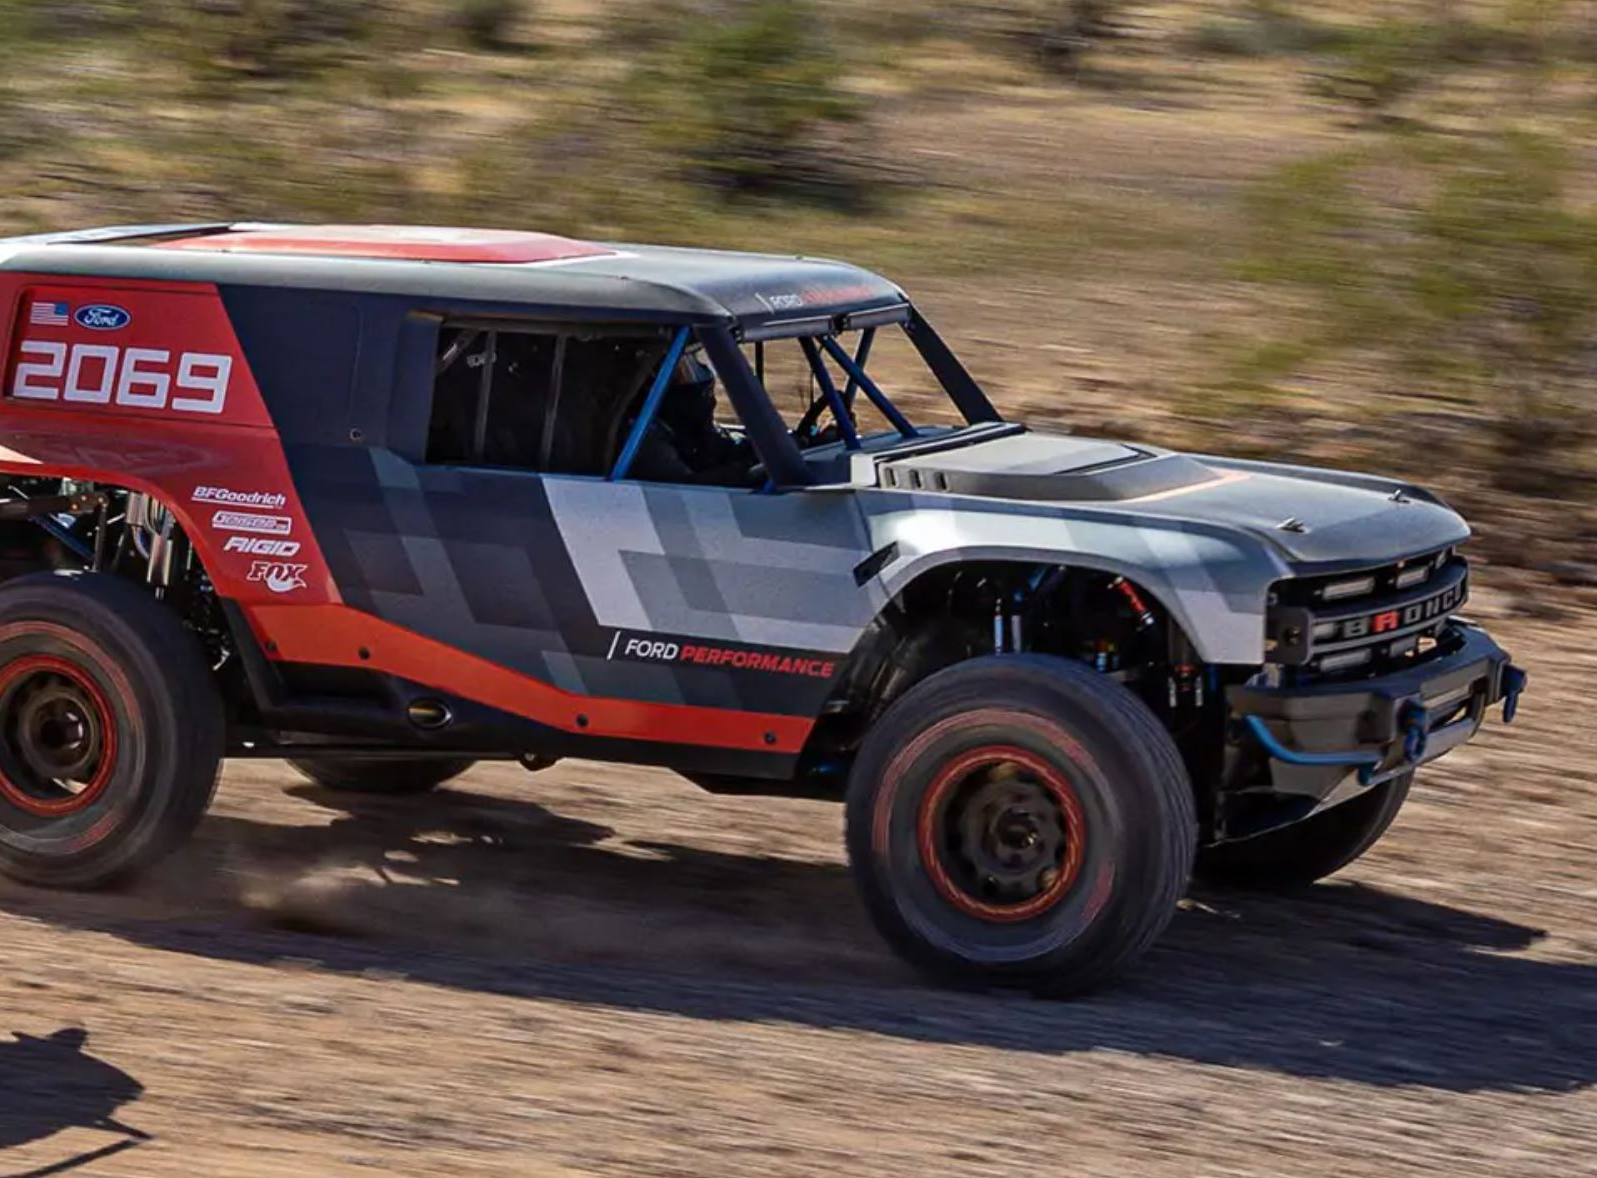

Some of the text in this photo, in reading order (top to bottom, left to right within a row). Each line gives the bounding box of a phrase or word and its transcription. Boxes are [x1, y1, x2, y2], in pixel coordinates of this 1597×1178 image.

[84, 308, 120, 326] Ford
[13, 340, 232, 414] 2069
[192, 485, 286, 506] BFGoodrich
[223, 536, 301, 557] RIGID
[246, 561, 307, 584] FOX
[625, 639, 835, 678] FORD PERFORMANCE
